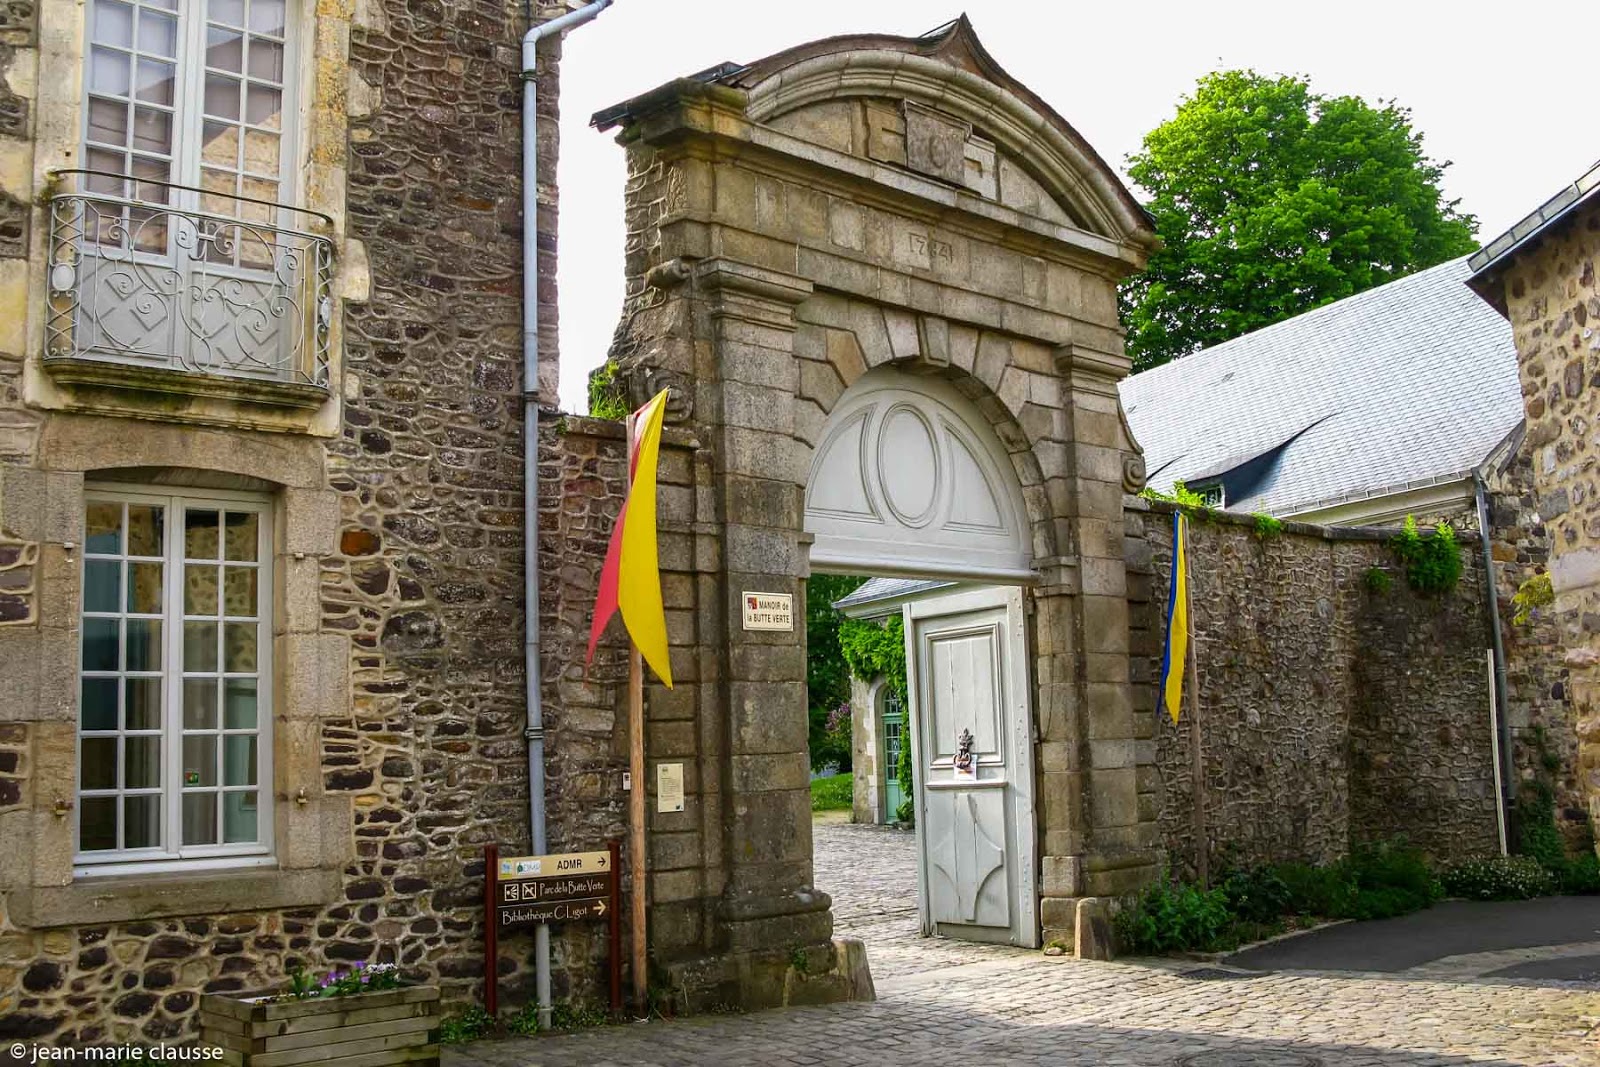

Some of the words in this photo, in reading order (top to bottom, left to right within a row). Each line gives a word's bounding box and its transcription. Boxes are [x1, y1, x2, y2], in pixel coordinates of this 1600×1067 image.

[759, 600, 780, 610] MANOIR
[782, 602, 789, 611] de
[747, 613, 752, 622] la
[754, 613, 771, 623] BUTTE
[772, 614, 790, 624] VERTE
[557, 859, 582, 870] ADMR
[540, 882, 554, 896] Parc
[554, 882, 562, 893] de
[562, 881, 568, 893] la
[568, 880, 587, 895] Butte
[586, 879, 604, 893] Verte
[502, 908, 553, 925] Bibliothèque
